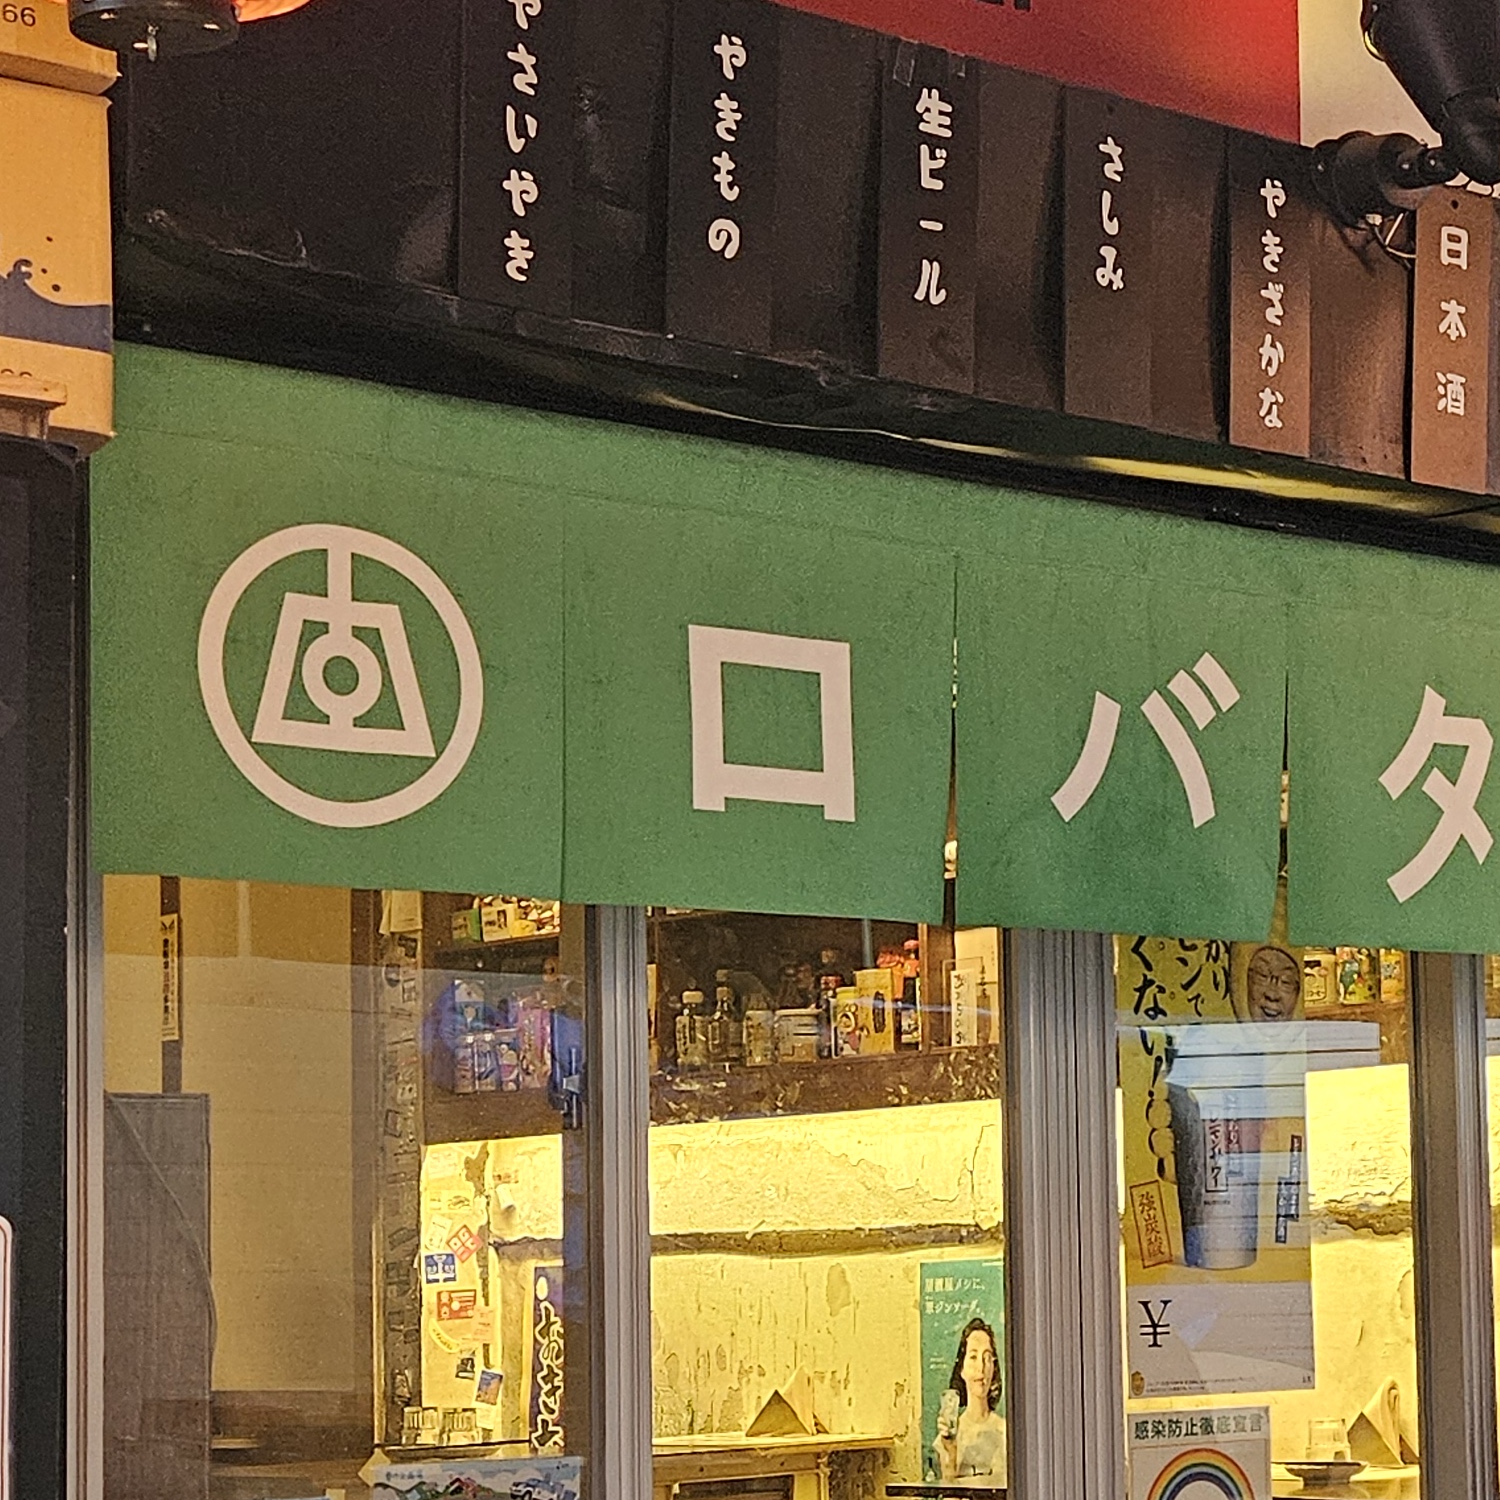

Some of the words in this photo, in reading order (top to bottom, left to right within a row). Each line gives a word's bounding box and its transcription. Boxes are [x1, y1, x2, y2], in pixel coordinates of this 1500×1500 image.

[503, 0, 539, 282] やさいやき
[708, 34, 748, 260] やきもの
[914, 86, 954, 307] 生ビール
[1096, 135, 1126, 293] さしみ
[1258, 177, 1287, 430] やきざかな
[1435, 225, 1469, 418] 日本酒
[1133, 1412, 1263, 1441] 感染防止徹底宣言
